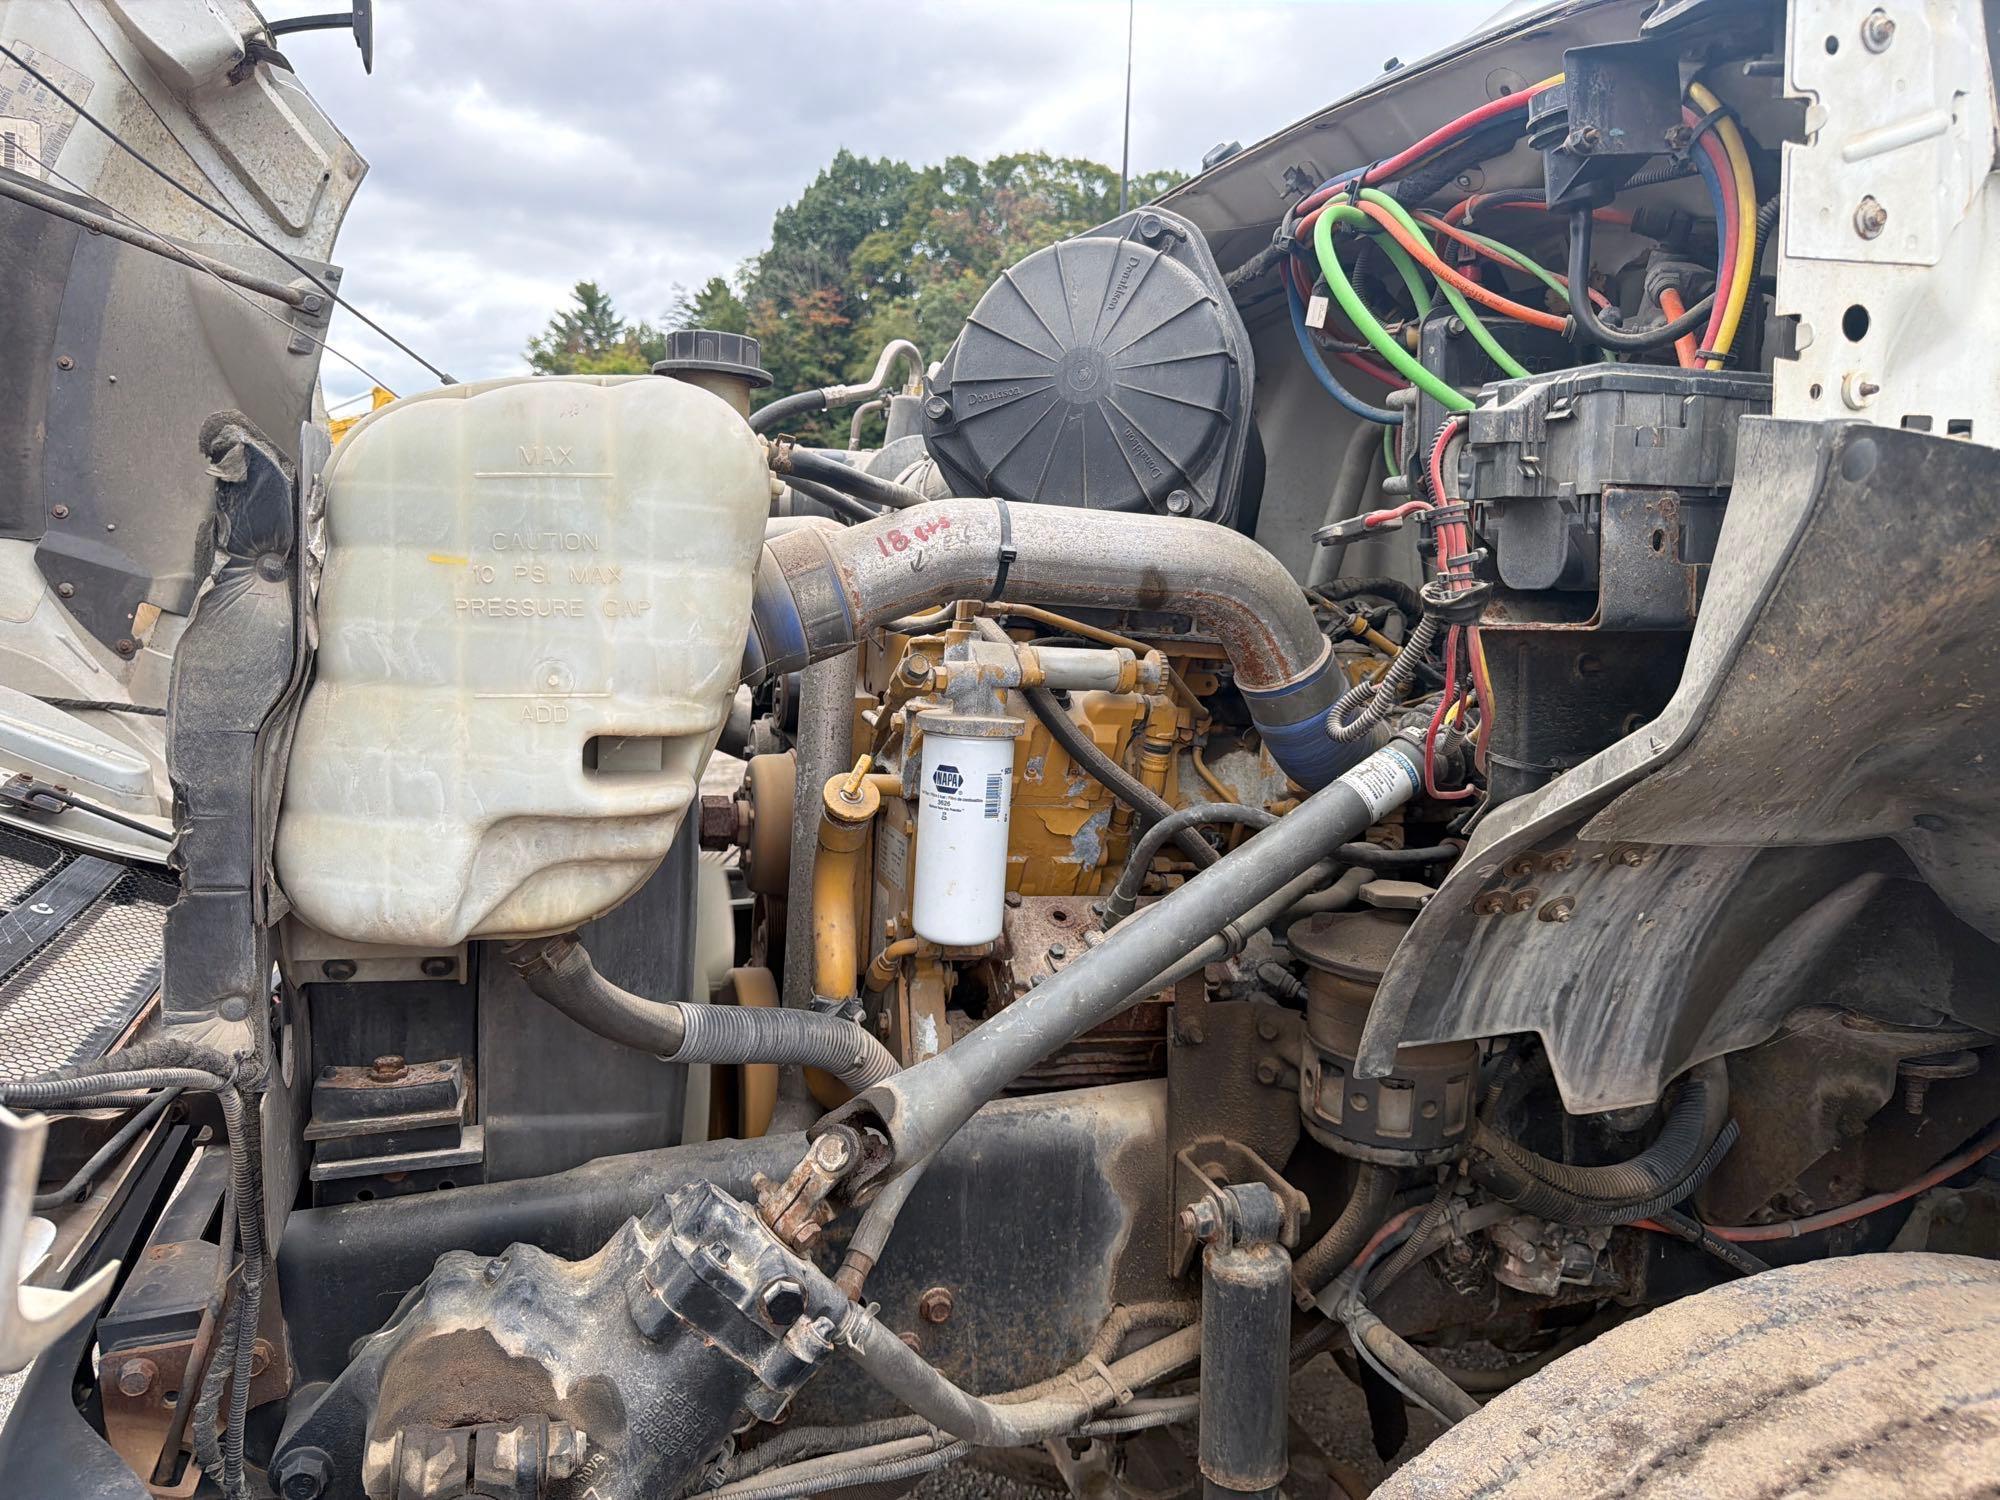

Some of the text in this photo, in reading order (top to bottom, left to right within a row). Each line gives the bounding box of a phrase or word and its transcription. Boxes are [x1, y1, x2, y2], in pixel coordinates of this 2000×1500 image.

[519, 446, 575, 465] MAX
[492, 532, 600, 551] CAUTION
[876, 529, 910, 557] 18
[472, 565, 624, 584] 10 PSI MAX
[455, 599, 651, 618] PRESSURE CAP
[520, 704, 569, 723] ADD
[937, 770, 958, 788] NAPA
